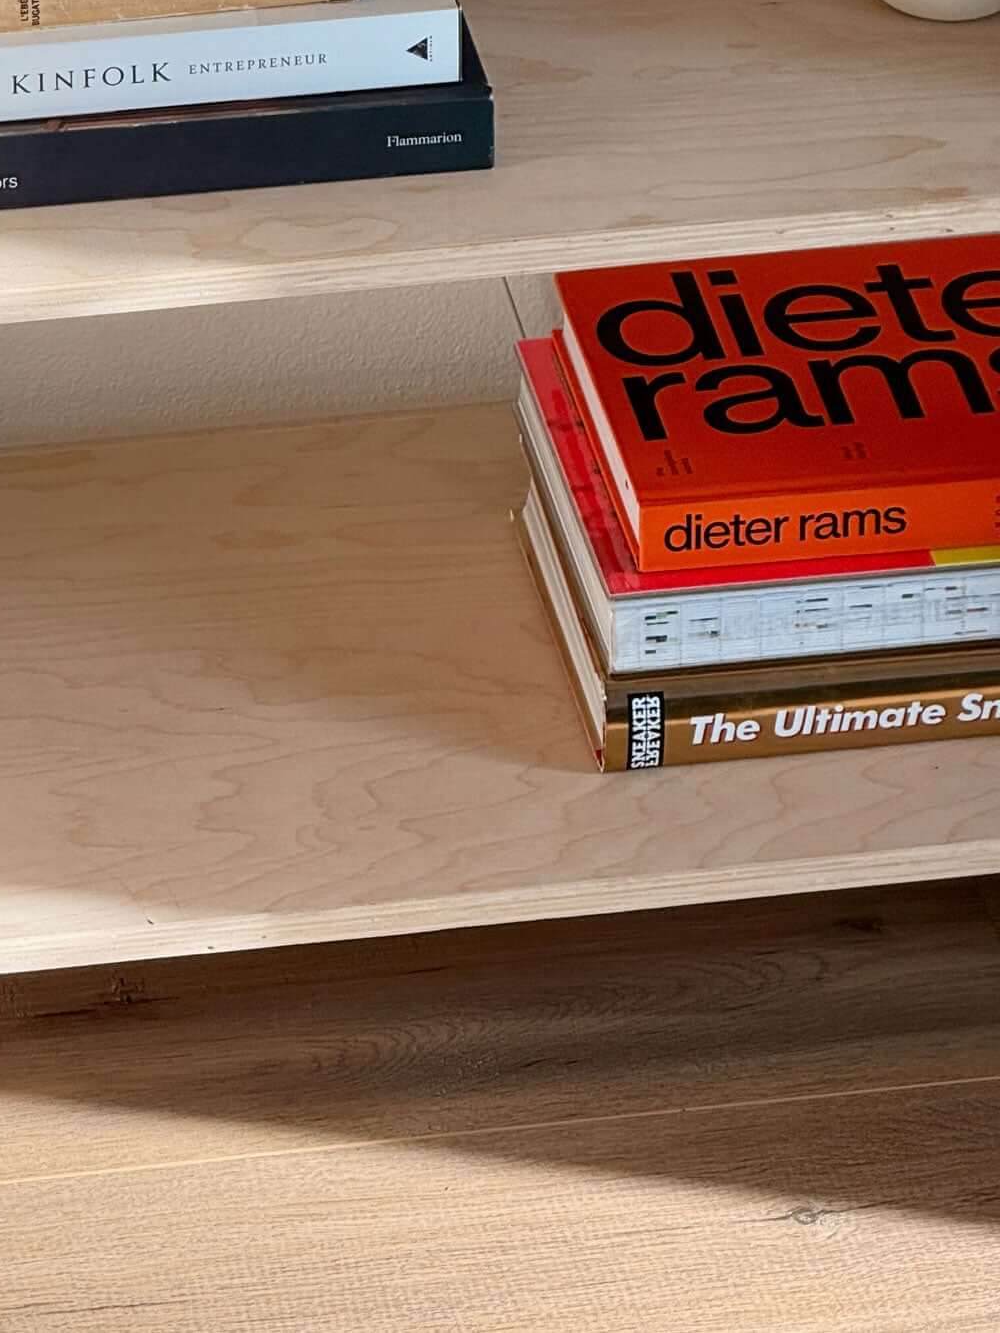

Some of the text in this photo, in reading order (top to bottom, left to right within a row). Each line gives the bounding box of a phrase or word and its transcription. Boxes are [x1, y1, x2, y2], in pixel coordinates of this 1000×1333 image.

[12, 61, 171, 95] KINFOLK
[188, 52, 328, 75] ENTREPRENEUR
[386, 131, 463, 148] Flammarion
[621, 348, 1000, 442] ram
[663, 505, 908, 553] dieter rams
[630, 696, 646, 769] SNEAKER
[689, 692, 1000, 746] The Ultimate Sn
